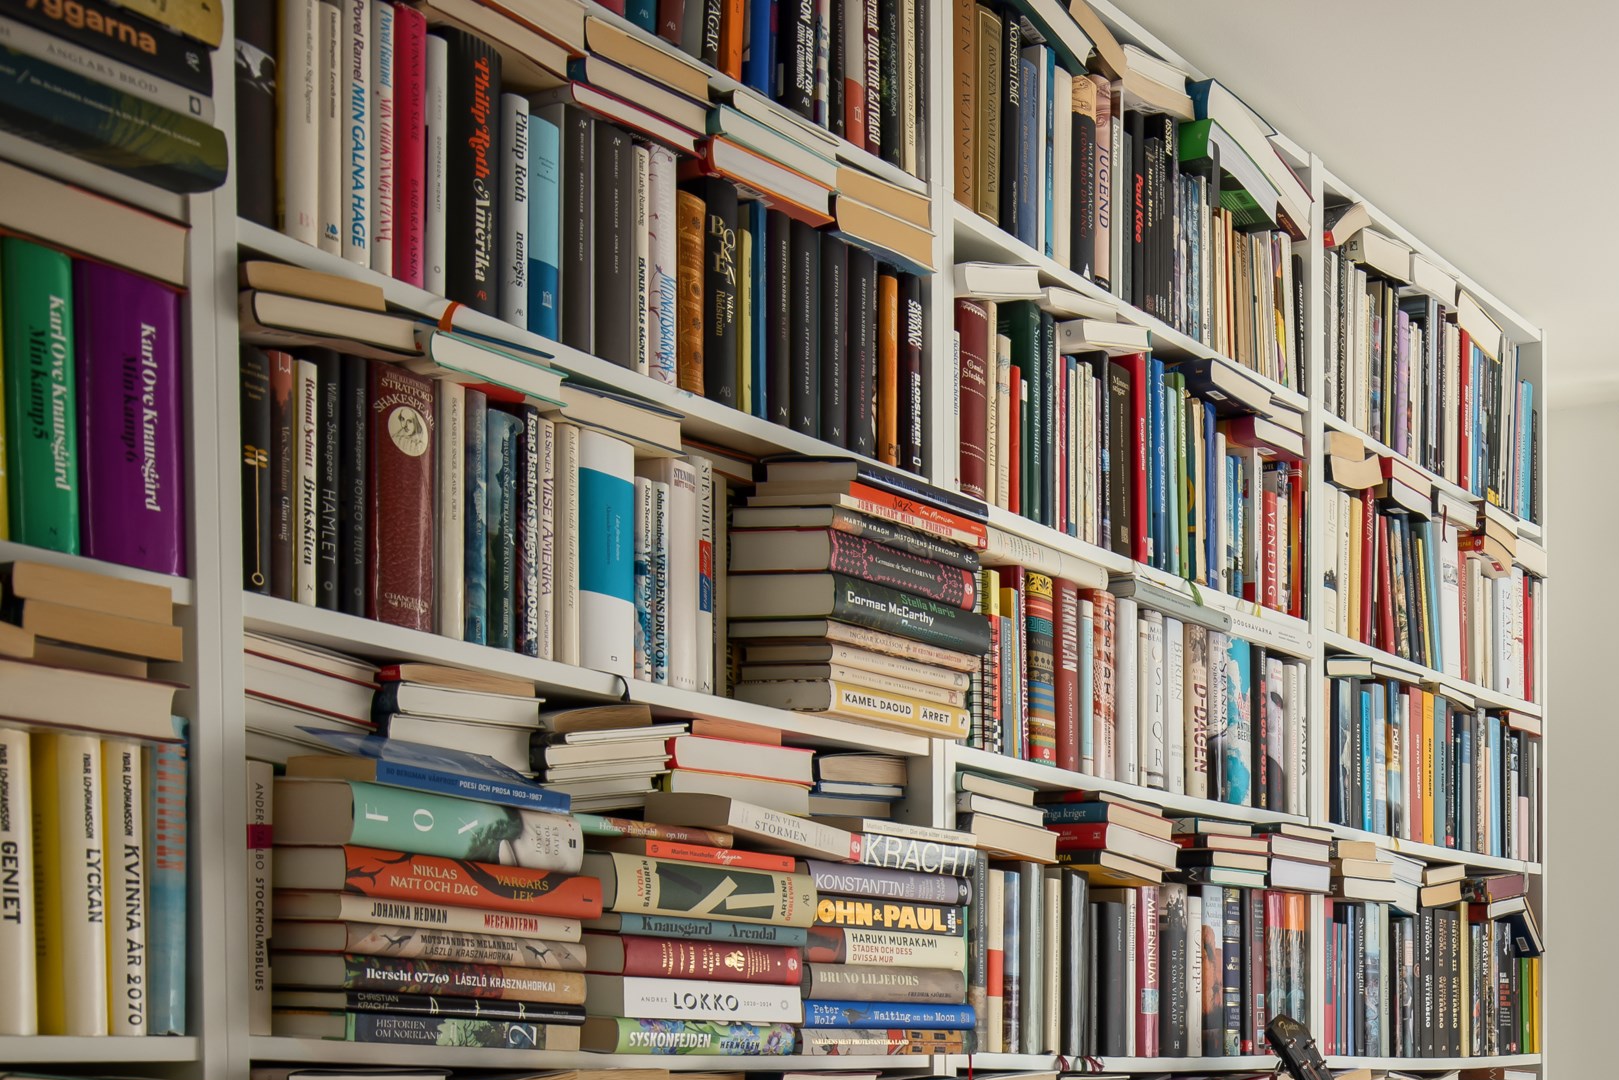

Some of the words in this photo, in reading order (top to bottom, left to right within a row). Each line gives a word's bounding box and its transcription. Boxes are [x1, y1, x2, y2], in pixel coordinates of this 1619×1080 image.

[353, 38, 364, 82] Ramel
[352, 83, 366, 125] MIN
[474, 58, 490, 119] Philip
[471, 121, 490, 180] Roth
[516, 109, 527, 164] Philip
[352, 126, 366, 190] GALNA
[516, 170, 526, 203] Roth
[1098, 145, 1109, 229] JUGEND
[352, 192, 366, 249] HAGE
[473, 179, 492, 282] Amerika
[515, 230, 524, 287] nemesis
[141, 323, 155, 366] Karl
[143, 370, 156, 400] Ove
[327, 383, 336, 417] William
[912, 373, 921, 446] BLODSLEKEN
[143, 402, 161, 512] Knausgård
[326, 422, 335, 482] Shakespeare
[657, 489, 665, 509] John
[323, 489, 336, 564] HAMLET
[656, 511, 665, 552] Steinbeck
[843, 516, 866, 528] MARTIN
[869, 523, 890, 535] KRAGH
[894, 532, 927, 548] HISTORIENS
[929, 543, 959, 558] ÅTERKONST
[1268, 511, 1276, 610] VENEDIG
[656, 554, 666, 611] VREDENS
[848, 591, 886, 612] Cormac
[889, 602, 934, 626] McCarthy
[901, 594, 927, 609] Stella
[930, 603, 955, 618] Maris
[655, 611, 665, 667] DRUVOR
[1104, 604, 1112, 695] ARENDT
[844, 693, 876, 710] KAMEL
[880, 701, 912, 717] DAOUD
[921, 706, 950, 724] ÄRRET
[1194, 683, 1207, 774] D-DAGEN
[460, 780, 477, 790] POESI
[478, 783, 489, 792] OCH
[491, 786, 510, 796] PROSA
[512, 790, 542, 801] 1903-1967
[754, 819, 808, 842] STORMEN
[764, 812, 780, 822] DEN
[782, 816, 801, 829] VITA
[865, 834, 974, 876] KRACHT
[2, 842, 20, 923] GENIET
[86, 849, 103, 923] LYCKAN
[124, 845, 141, 932] KVINNA
[391, 876, 420, 891] NATT
[422, 879, 450, 893] OCH
[453, 882, 478, 896] DAG
[413, 864, 457, 880] NIKLAS
[496, 875, 549, 891] VARGARS
[642, 859, 650, 908] SANDGREN
[815, 873, 904, 897] KONSTANTIN
[371, 902, 411, 921] JOHANNA
[414, 906, 447, 923] HEDMAN
[513, 890, 534, 903] LEK
[484, 914, 538, 932] MECENATERNA
[814, 899, 872, 926] OHN
[884, 905, 947, 932] PAUL
[421, 934, 474, 947] MOTSTÅNDETS
[477, 940, 518, 951] MELANKOLI
[728, 924, 776, 941] Arendal
[852, 933, 886, 945] HARUKI
[888, 936, 937, 948] MURAKAMI
[1148, 898, 1156, 984] MILLENNIUM
[127, 938, 143, 968] ÅR
[852, 944, 878, 953] STADEN
[879, 946, 893, 954] OCH
[896, 948, 912, 956] DESS
[852, 954, 876, 963] OVISSA
[366, 968, 411, 982] Herscht
[414, 971, 449, 984] 07769
[455, 973, 487, 987] LÁSZLÓ
[489, 976, 556, 992] KRASZNAHORKAI
[819, 972, 859, 985] BRUNO
[861, 973, 920, 987] LILJEFORS
[127, 973, 143, 1027] 2070
[674, 991, 739, 1012] LOKKO
[813, 1004, 839, 1016] Peter
[873, 1011, 910, 1022] Waiting
[913, 1014, 922, 1022] on
[923, 1012, 934, 1022] the
[936, 1012, 955, 1022] Moon
[376, 1019, 426, 1030] HISTORIEN
[376, 1028, 390, 1038] OM
[393, 1029, 443, 1039] NORRLAND
[814, 1015, 836, 1025] Wolf
[629, 1031, 711, 1048] SYSKONFEJDEN
